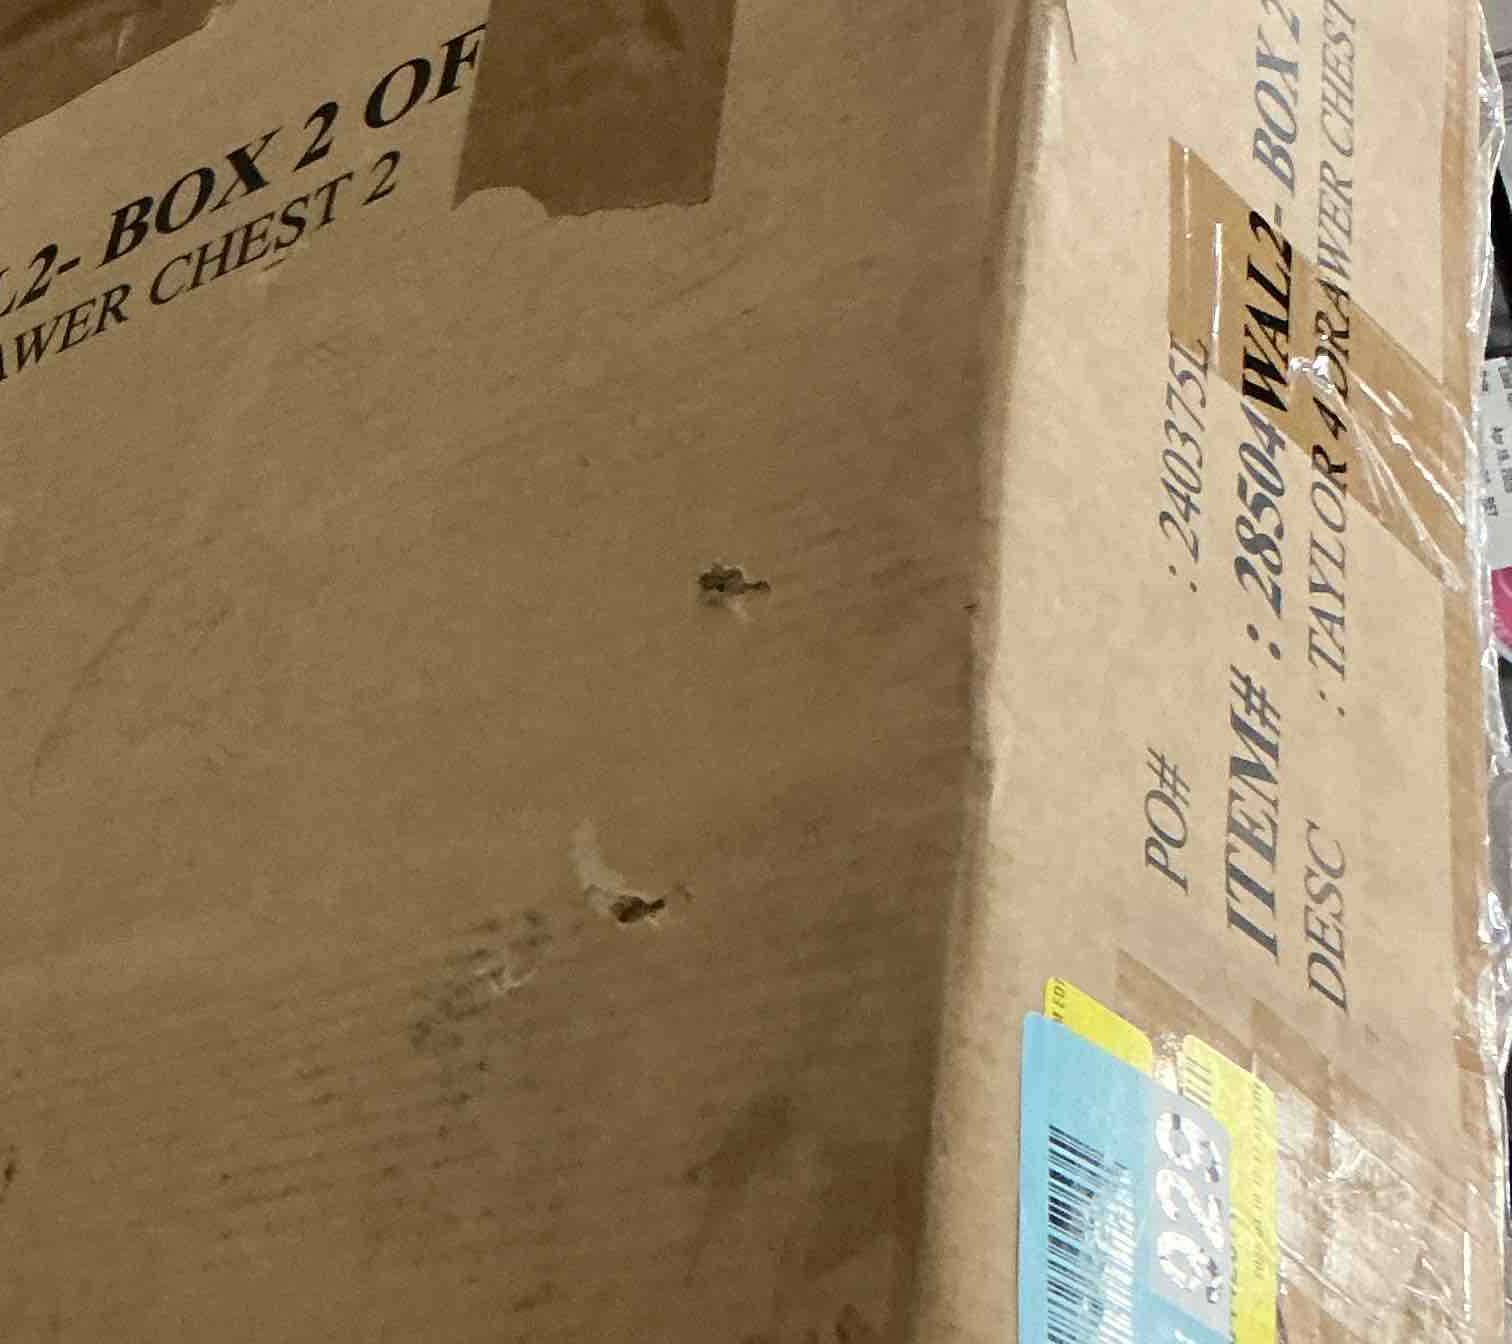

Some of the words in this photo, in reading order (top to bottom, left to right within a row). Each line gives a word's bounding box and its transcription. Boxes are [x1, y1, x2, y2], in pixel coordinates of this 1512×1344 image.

[97, 127, 284, 270] BOX
[290, 100, 341, 174] 2
[362, 26, 487, 136] OF
[1252, 25, 1296, 199] BOX
[148, 168, 355, 309] CHEST
[363, 148, 403, 207] 2
[1313, 160, 1353, 401] DRAWER
[1158, 334, 1210, 562] 240375L
[1311, 394, 1347, 441] 4
[1307, 443, 1348, 682] TAYLOR
[1144, 747, 1191, 895] PO#
[1225, 662, 1283, 966] ITEM#
[1303, 818, 1348, 1016] DESC
